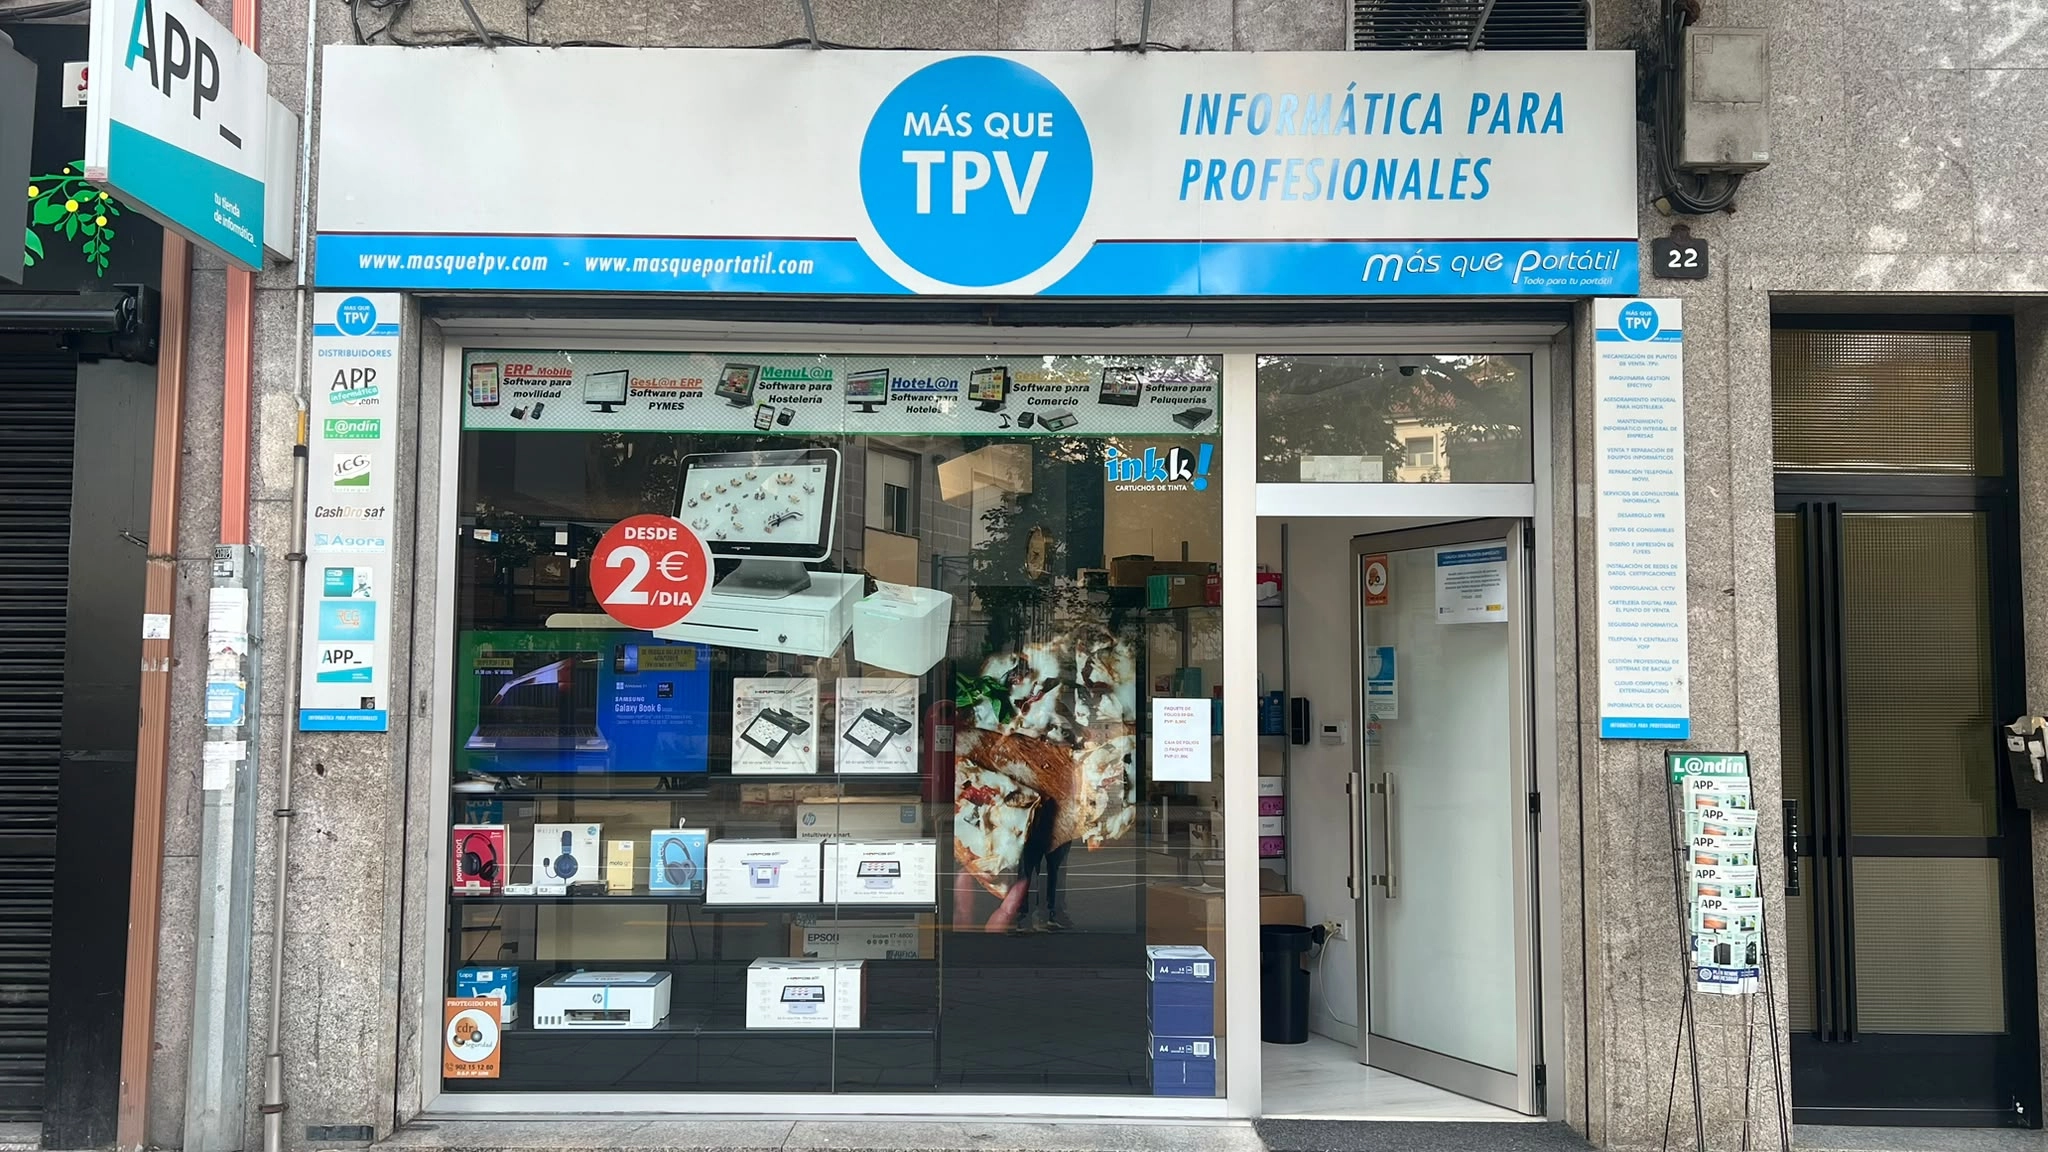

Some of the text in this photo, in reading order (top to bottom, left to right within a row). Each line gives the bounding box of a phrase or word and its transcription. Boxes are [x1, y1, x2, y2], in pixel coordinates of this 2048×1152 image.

[1180, 81, 1564, 136] INFORMÁTICA PARA
[903, 104, 1053, 140] MÁS QUE
[902, 150, 1049, 215] TPV
[1180, 157, 1491, 201] PROFESIONALES
[214, 192, 240, 218] tu tienda
[214, 209, 222, 224] de
[358, 250, 814, 278] www.masquetpv.com www.masqueportatil.com
[1450, 252, 1504, 278] que
[1668, 250, 1699, 269] 22
[1523, 276, 1613, 286] Todo para tu portátil
[344, 312, 369, 324] TPV
[1626, 318, 1652, 329] TPV
[318, 349, 392, 358] DISTRIBUIDORES
[504, 364, 572, 376] ERP Mobile
[761, 366, 833, 379] MenuL@n
[331, 368, 376, 390] APP
[503, 378, 572, 388] Software para
[680, 378, 702, 387] ERP
[892, 377, 958, 390] HoteL@n
[759, 382, 832, 392] Software para
[1013, 384, 1062, 392] Software
[513, 390, 561, 398] movilidad
[630, 388, 703, 400] Software para
[768, 394, 823, 404] Hostelería
[648, 402, 684, 410] PYMES
[1028, 397, 1079, 405] Comercio
[1150, 396, 1207, 405] Peluquerías
[338, 455, 364, 474] ICG
[364, 506, 385, 518] sat
[624, 527, 677, 540] DESDE
[615, 704, 637, 714] Galaxy
[639, 704, 655, 712] Book
[456, 859, 464, 882] power
[456, 1022, 474, 1033] cdr
